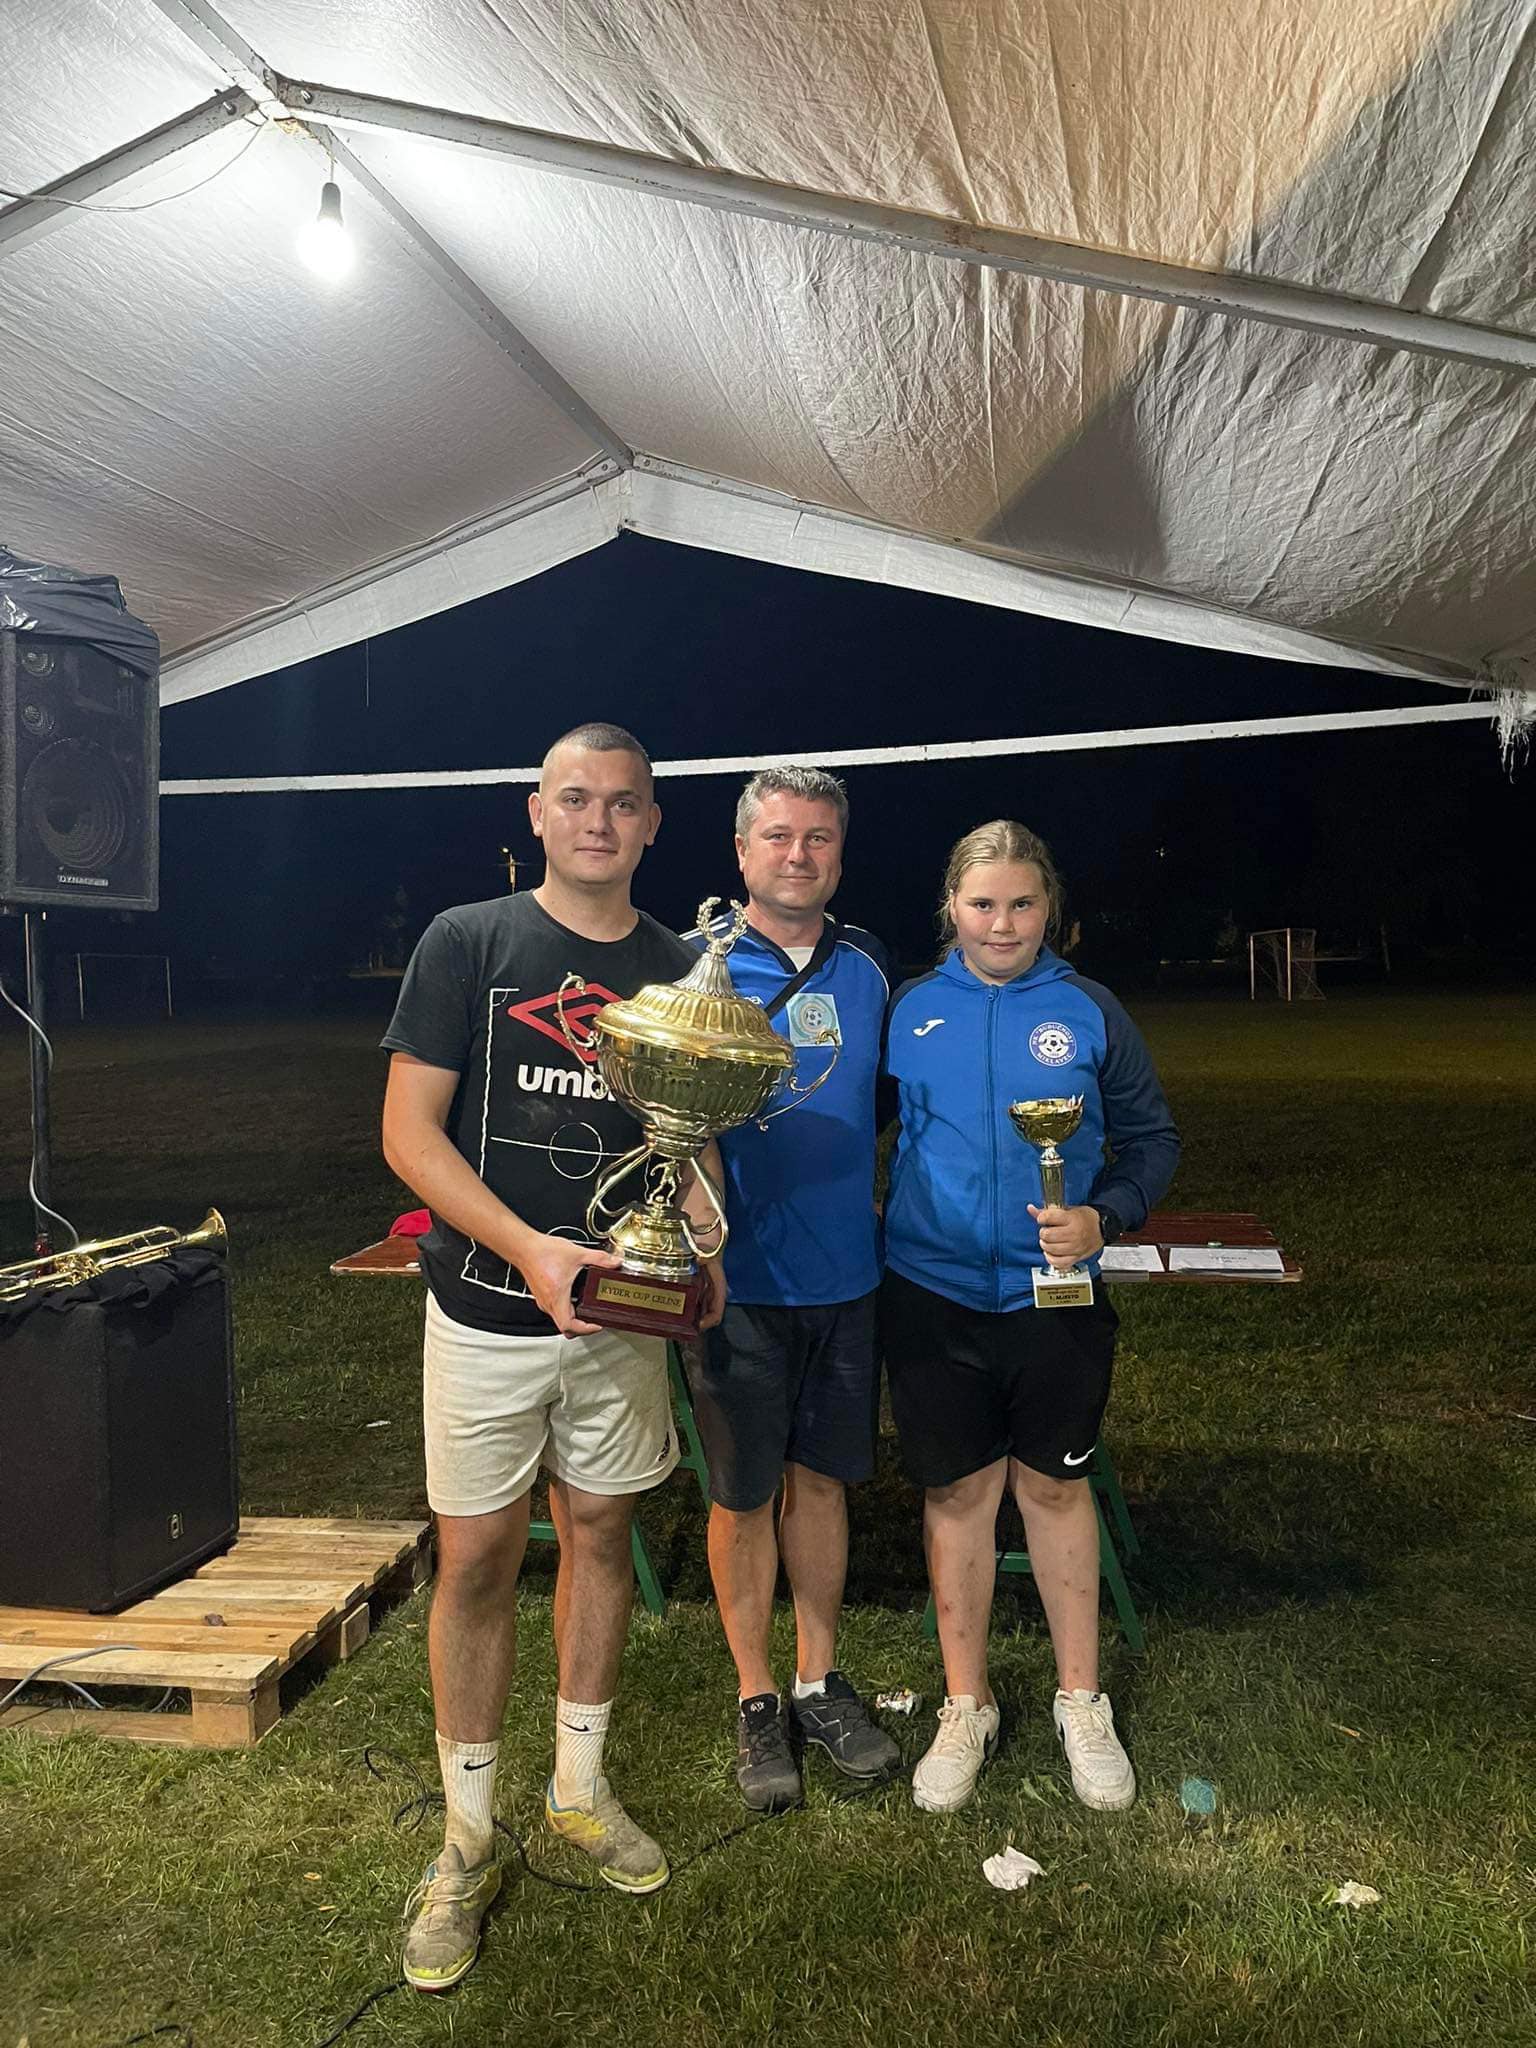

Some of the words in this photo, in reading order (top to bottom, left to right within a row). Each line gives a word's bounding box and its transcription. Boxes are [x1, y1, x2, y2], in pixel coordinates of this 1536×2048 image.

[517, 1064, 617, 1102] umb
[601, 1287, 630, 1298] RYDER
[633, 1292, 649, 1301] CUP
[652, 1295, 681, 1306] CELINE
